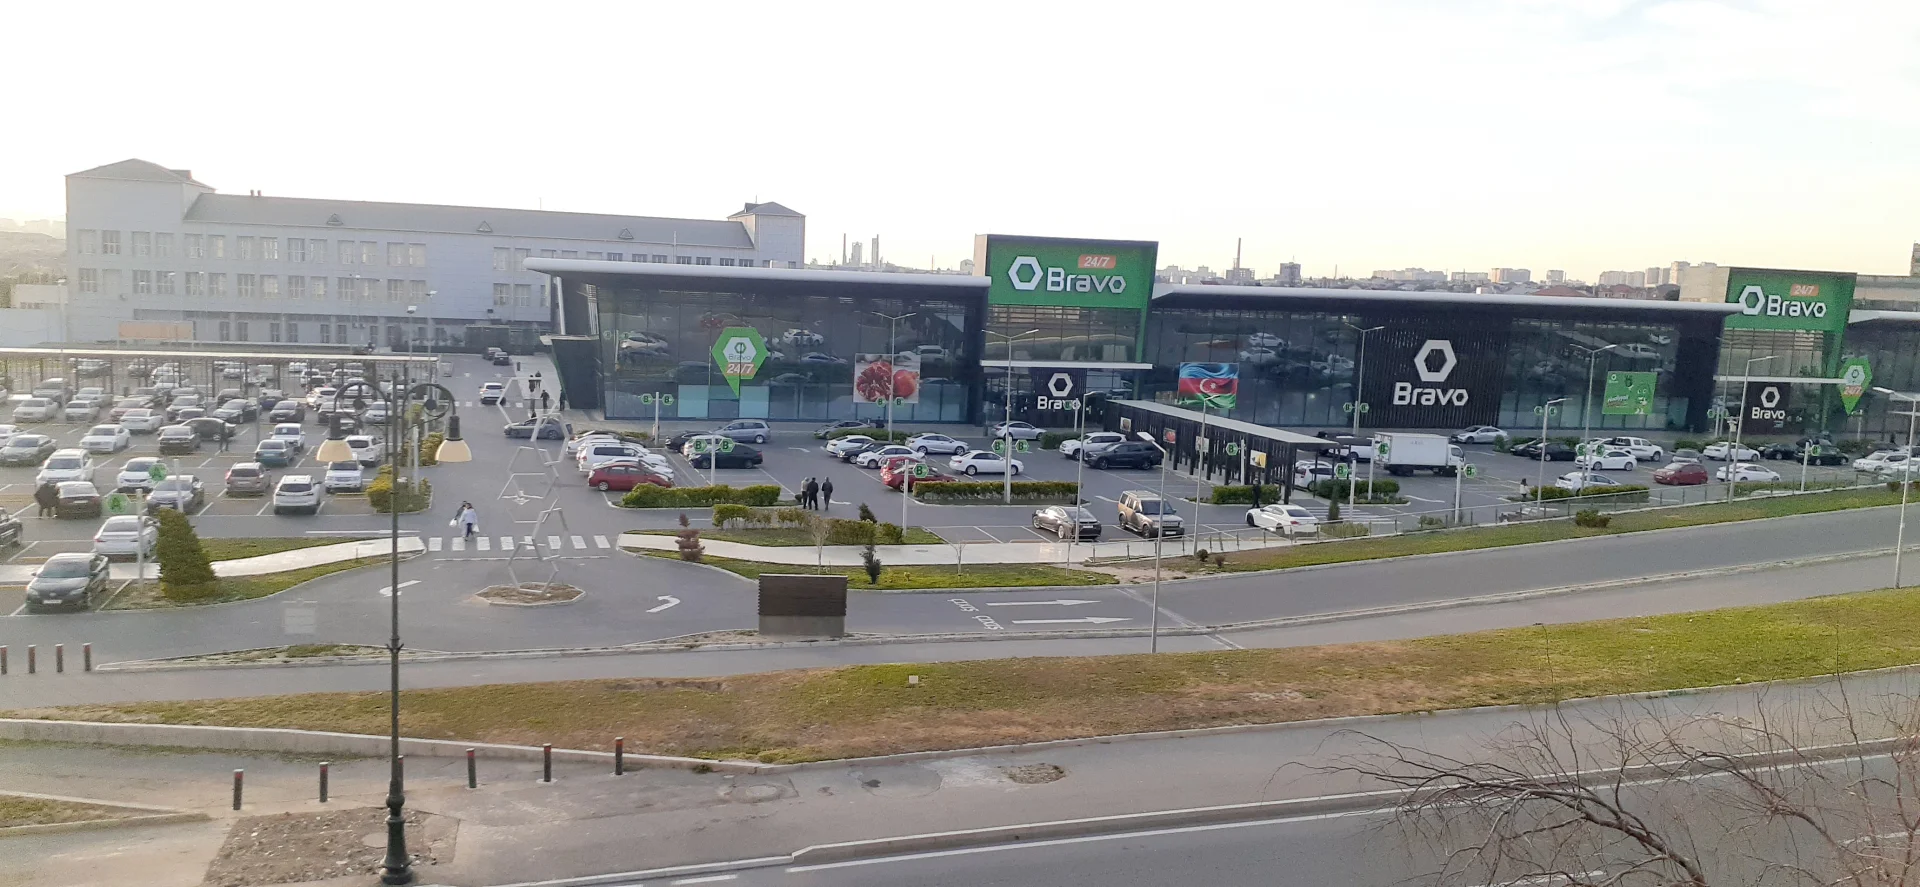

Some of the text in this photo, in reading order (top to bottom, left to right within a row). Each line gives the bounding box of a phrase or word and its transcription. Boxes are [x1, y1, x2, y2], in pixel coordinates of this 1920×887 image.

[1084, 256, 1110, 267] 24/7
[1047, 267, 1126, 293] Bravo
[1794, 285, 1815, 295] 24/7
[1766, 295, 1827, 318] Bravo
[726, 364, 754, 374] 24/7
[1393, 382, 1469, 406] Bravo
[1752, 406, 1786, 420] Bravo
